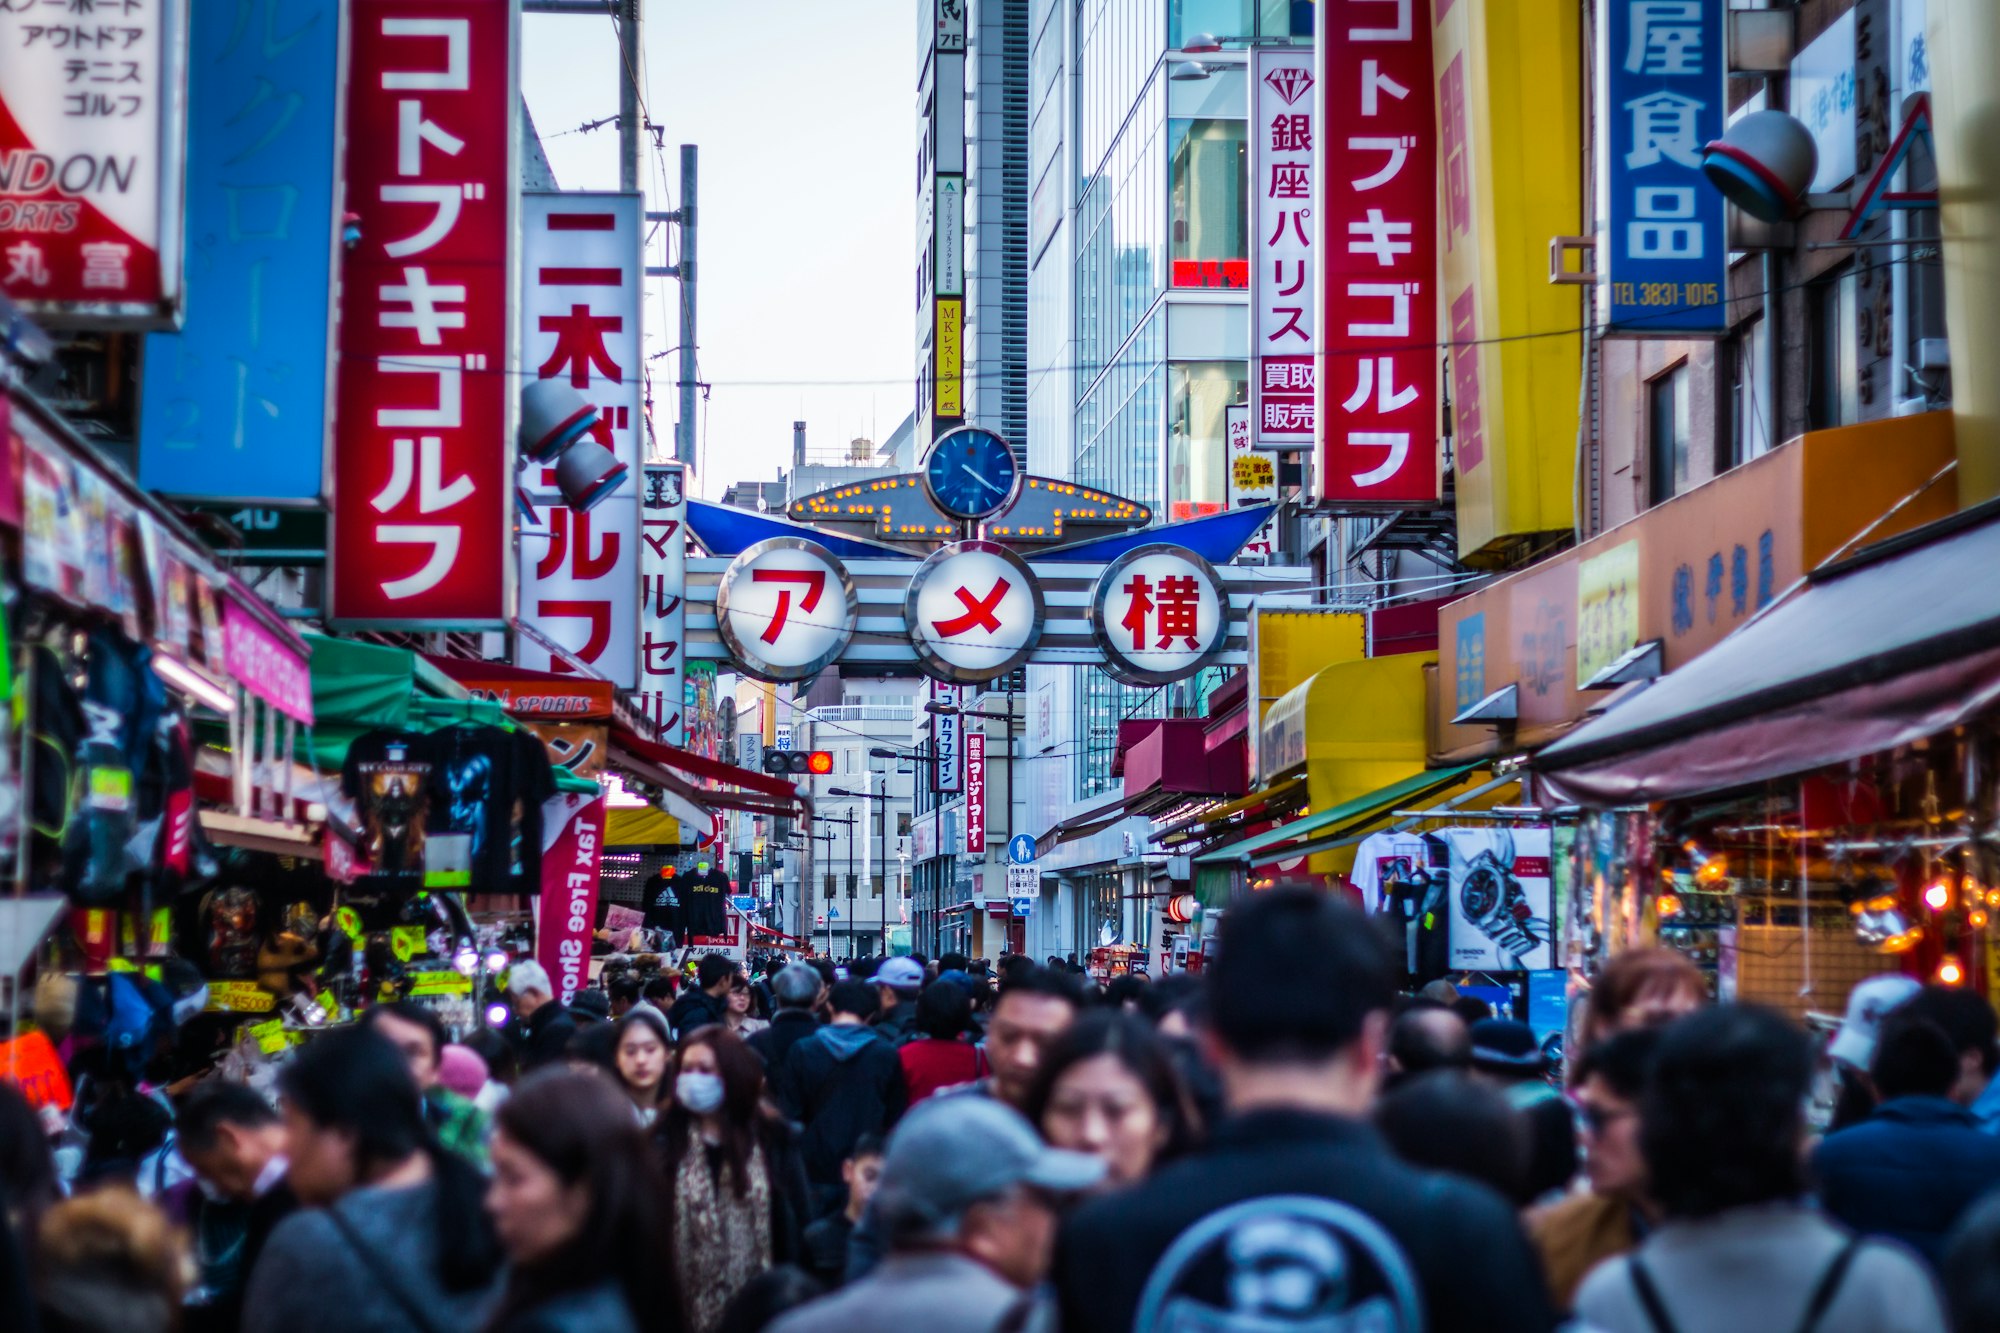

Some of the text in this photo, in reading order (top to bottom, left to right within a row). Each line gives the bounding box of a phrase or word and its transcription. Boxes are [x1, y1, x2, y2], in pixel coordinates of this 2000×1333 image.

[20, 25, 144, 48] アウトドア
[940, 34, 961, 46] 7F
[63, 60, 141, 83] テニス
[63, 93, 142, 117] ゴルフ
[1623, 0, 1706, 260] 屋食品
[1268, 114, 1312, 342] 銀座パリス
[1342, 0, 1420, 488] コトブキゴルフ
[3, 240, 130, 289] 丸富
[1614, 282, 1718, 306] TEL 3831-1015
[370, 18, 487, 600] コトブキゴルフ
[942, 307, 955, 394] MKレストラン
[1264, 363, 1314, 390] 買取
[1264, 403, 1314, 430] 販売
[538, 213, 622, 673] 二木ルフ
[514, 696, 592, 713] SPORTS
